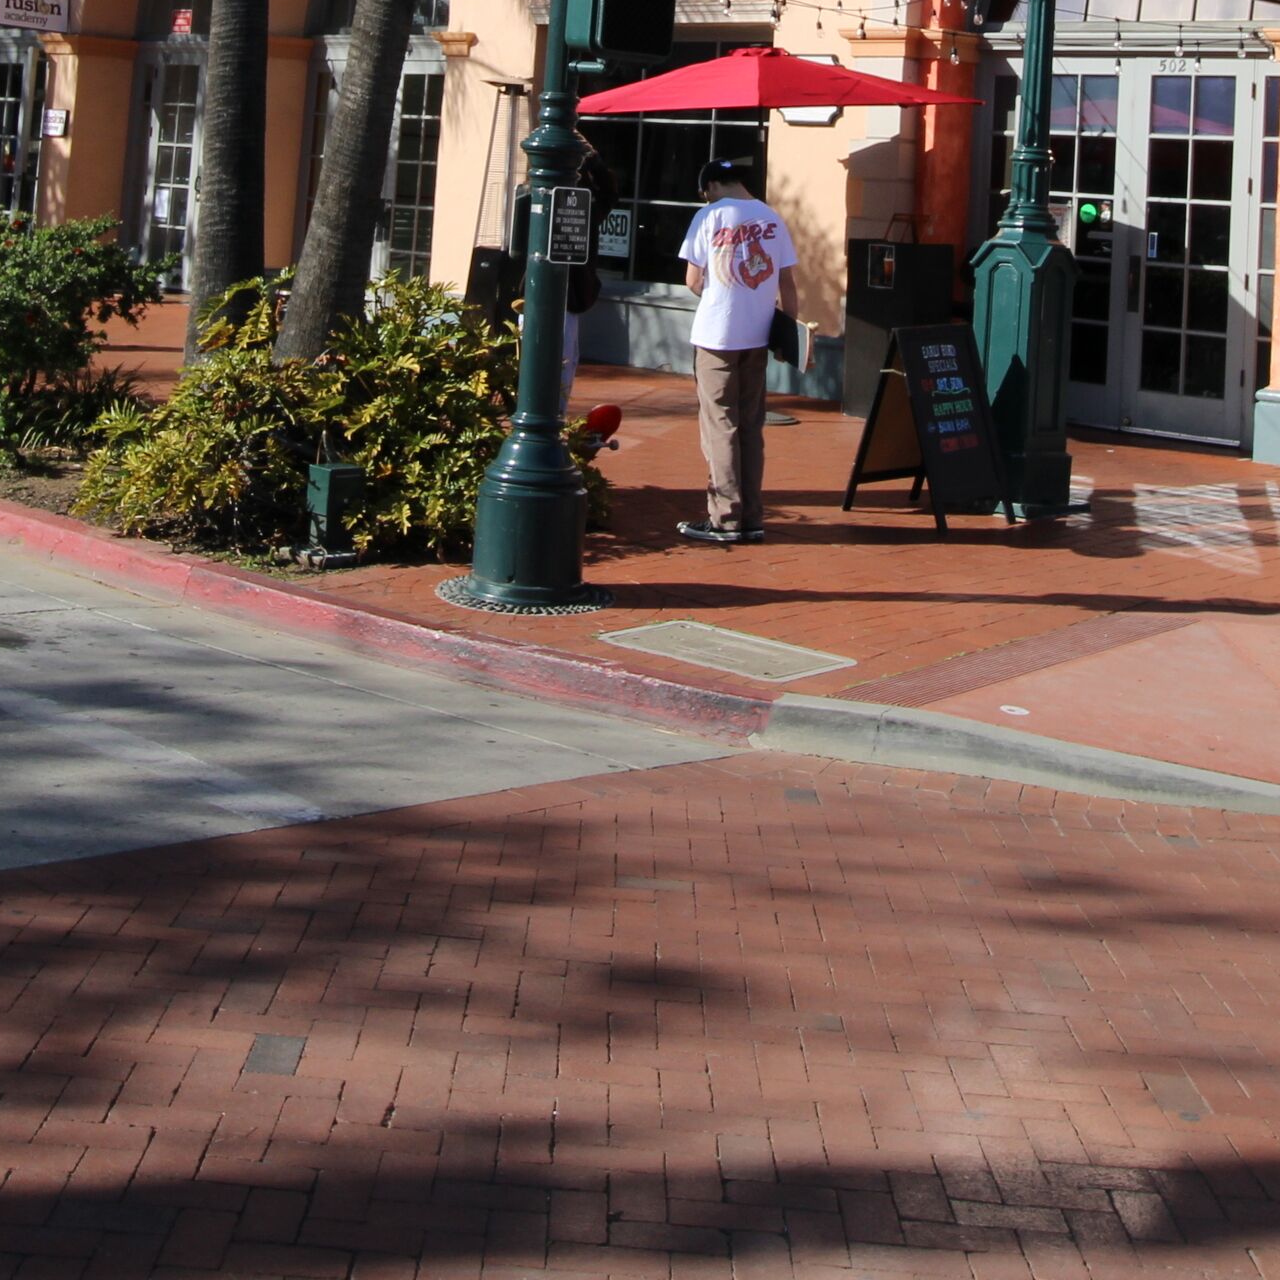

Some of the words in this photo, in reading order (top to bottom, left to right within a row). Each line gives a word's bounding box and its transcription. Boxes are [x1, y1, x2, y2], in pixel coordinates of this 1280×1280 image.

[4, 12, 48, 27] academy
[1159, 59, 1187, 73] 502
[566, 196, 577, 207] NO
